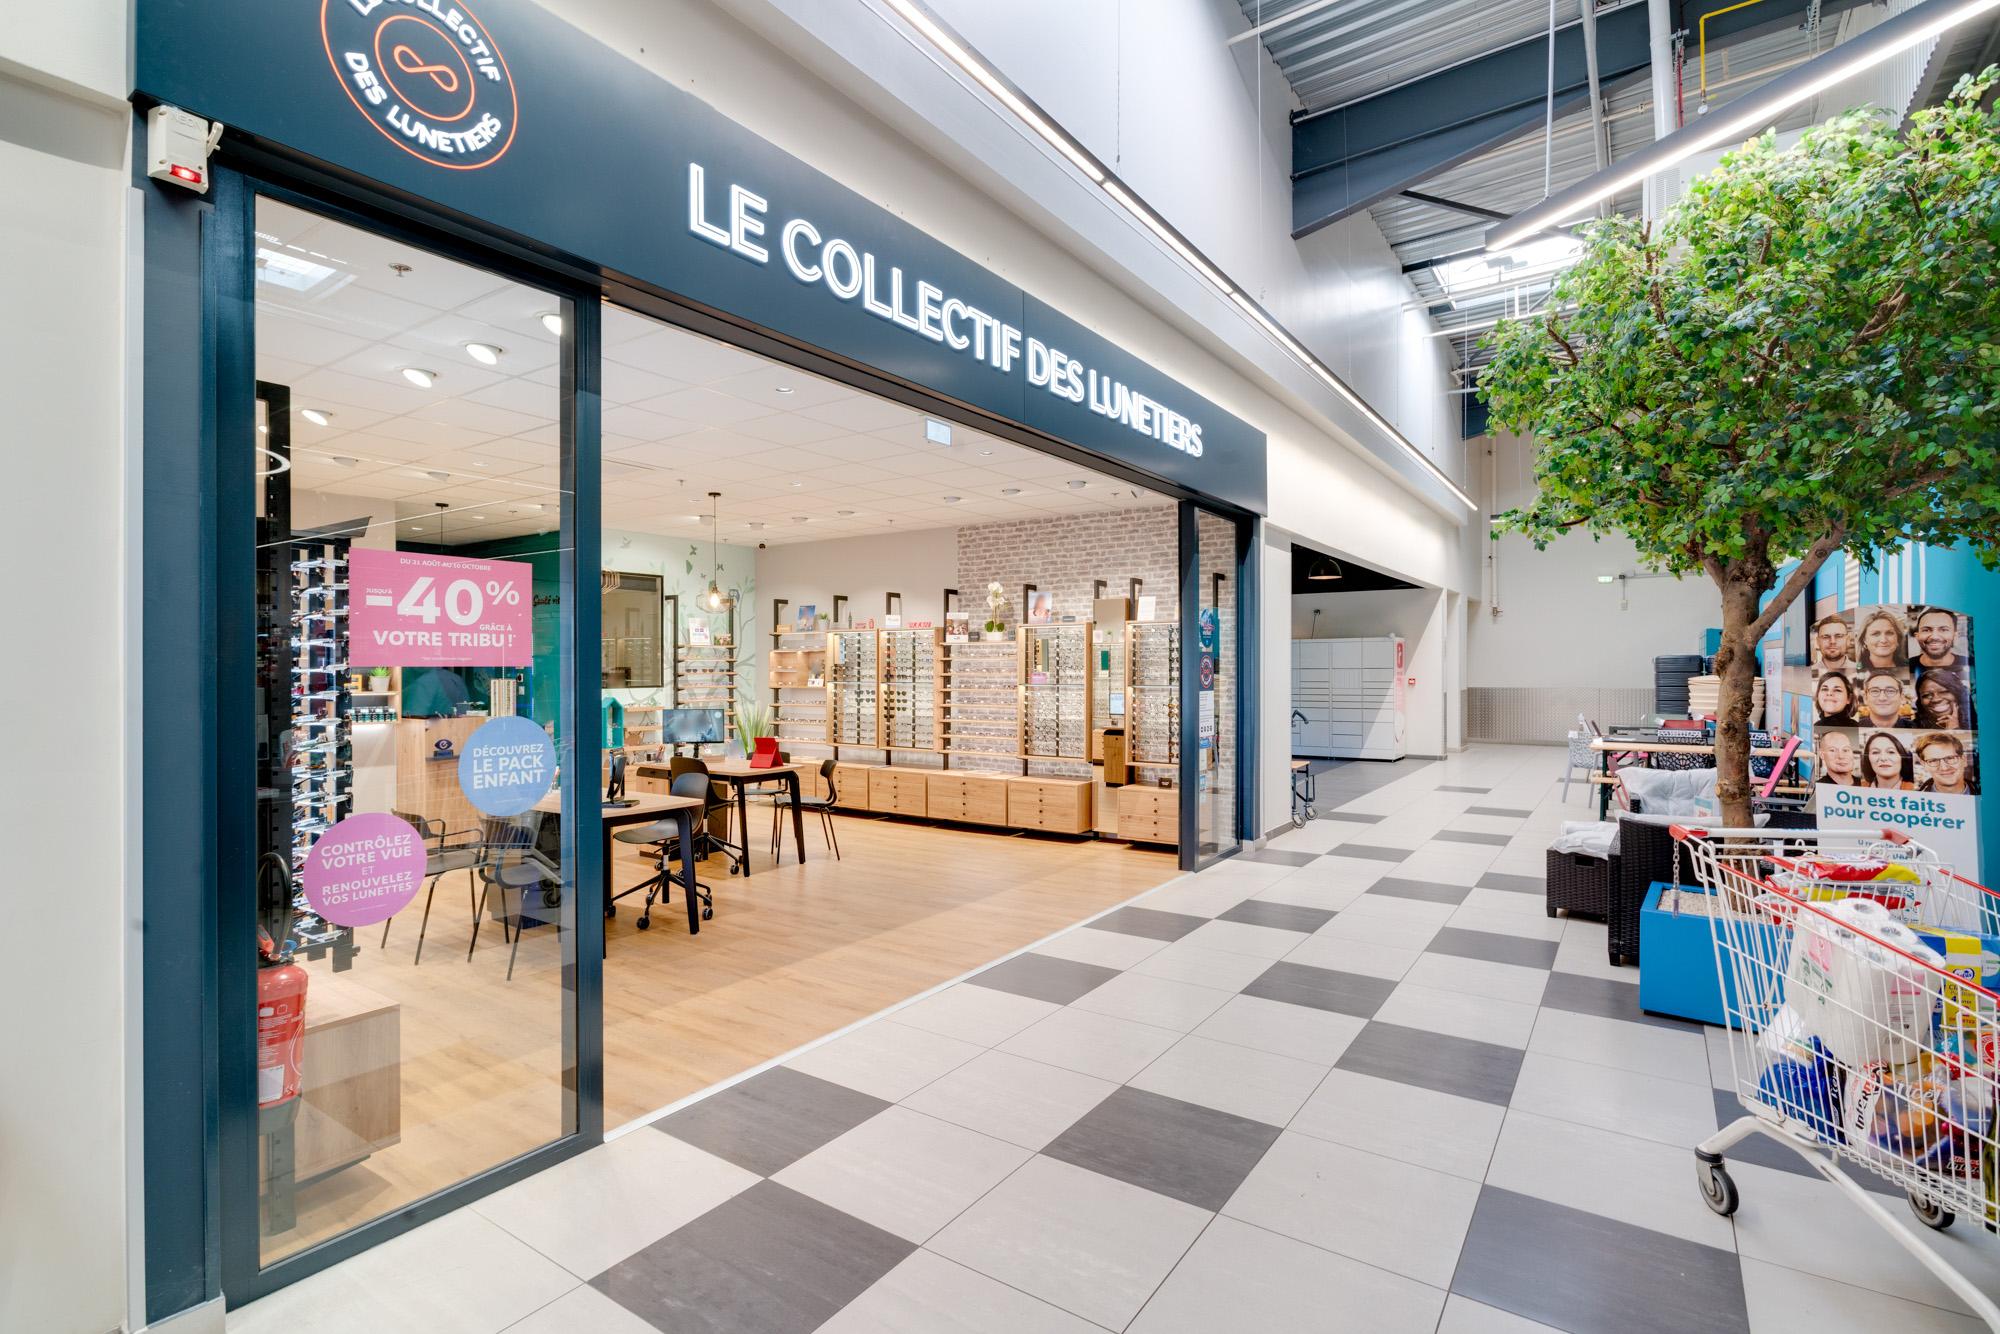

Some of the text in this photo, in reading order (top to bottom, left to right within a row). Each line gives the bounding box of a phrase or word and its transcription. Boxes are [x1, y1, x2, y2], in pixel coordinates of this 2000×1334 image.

[344, 52, 501, 153] DES LUNETIERS
[689, 162, 1203, 457] LE COLLECTIF DES LUNETIERS
[461, 562, 492, 571] OCTOBRE
[373, 630, 443, 647] VOTRE
[479, 623, 512, 632] GRÂCE À
[473, 743, 544, 758] DÉCOUVREZ
[473, 754, 544, 774] LE PACK
[473, 769, 545, 789] ENFANT
[1836, 790, 1946, 814] On est faits
[1824, 805, 1965, 830] pour coopérer
[321, 833, 412, 857] CONTRÔLEZ
[322, 846, 412, 870] VOTRE VUE
[361, 866, 374, 876] ET
[322, 871, 413, 896] RENOUVELEZ
[322, 882, 413, 906] VOS LUNETTES
